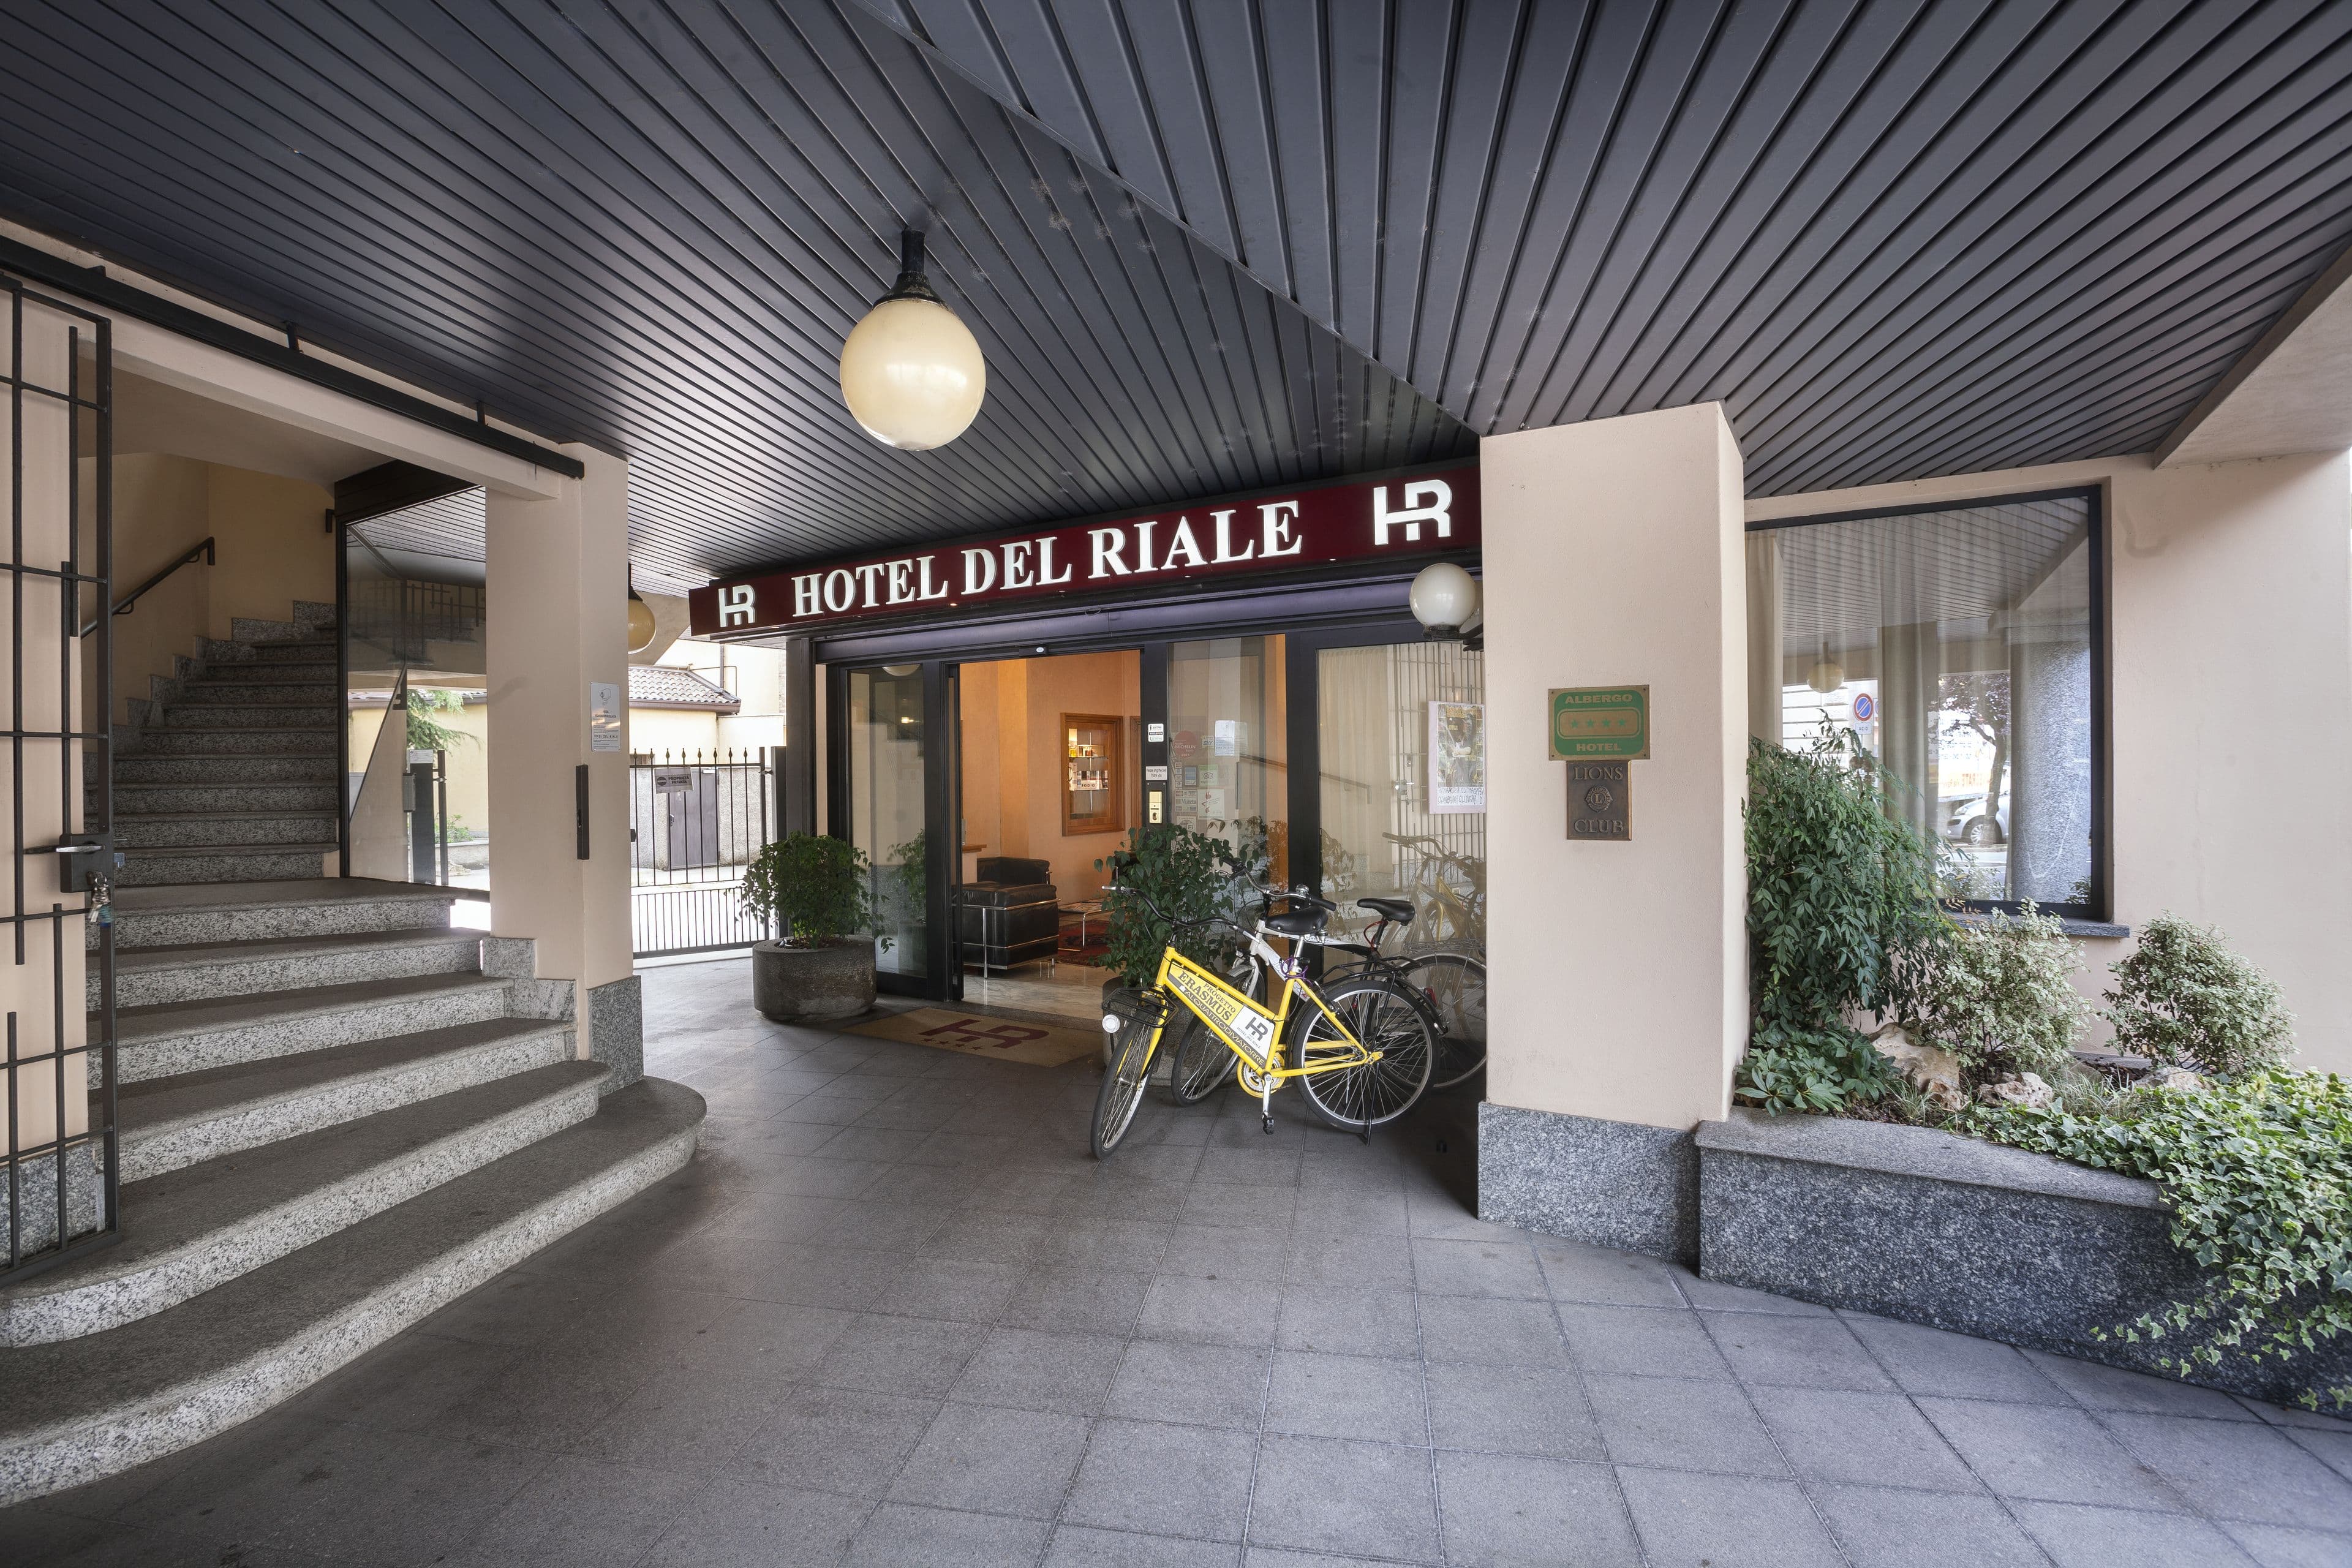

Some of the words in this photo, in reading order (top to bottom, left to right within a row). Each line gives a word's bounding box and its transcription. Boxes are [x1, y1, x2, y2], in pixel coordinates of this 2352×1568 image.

[718, 584, 756, 628] HR
[791, 556, 948, 617] HOTEL
[960, 536, 1072, 595] DEL
[1088, 499, 1303, 579] RIALE
[1373, 479, 1452, 546] HR
[1564, 694, 1633, 704] ALBERGO
[1576, 743, 1622, 752] HOTEL
[1573, 766, 1624, 781] LIONS
[1574, 818, 1624, 834] CLUB
[1178, 971, 1232, 1021] ERASMUS
[1204, 983, 1236, 1013] PROGETTO
[918, 1019, 1050, 1049] HR
[1245, 1016, 1268, 1041] HR
